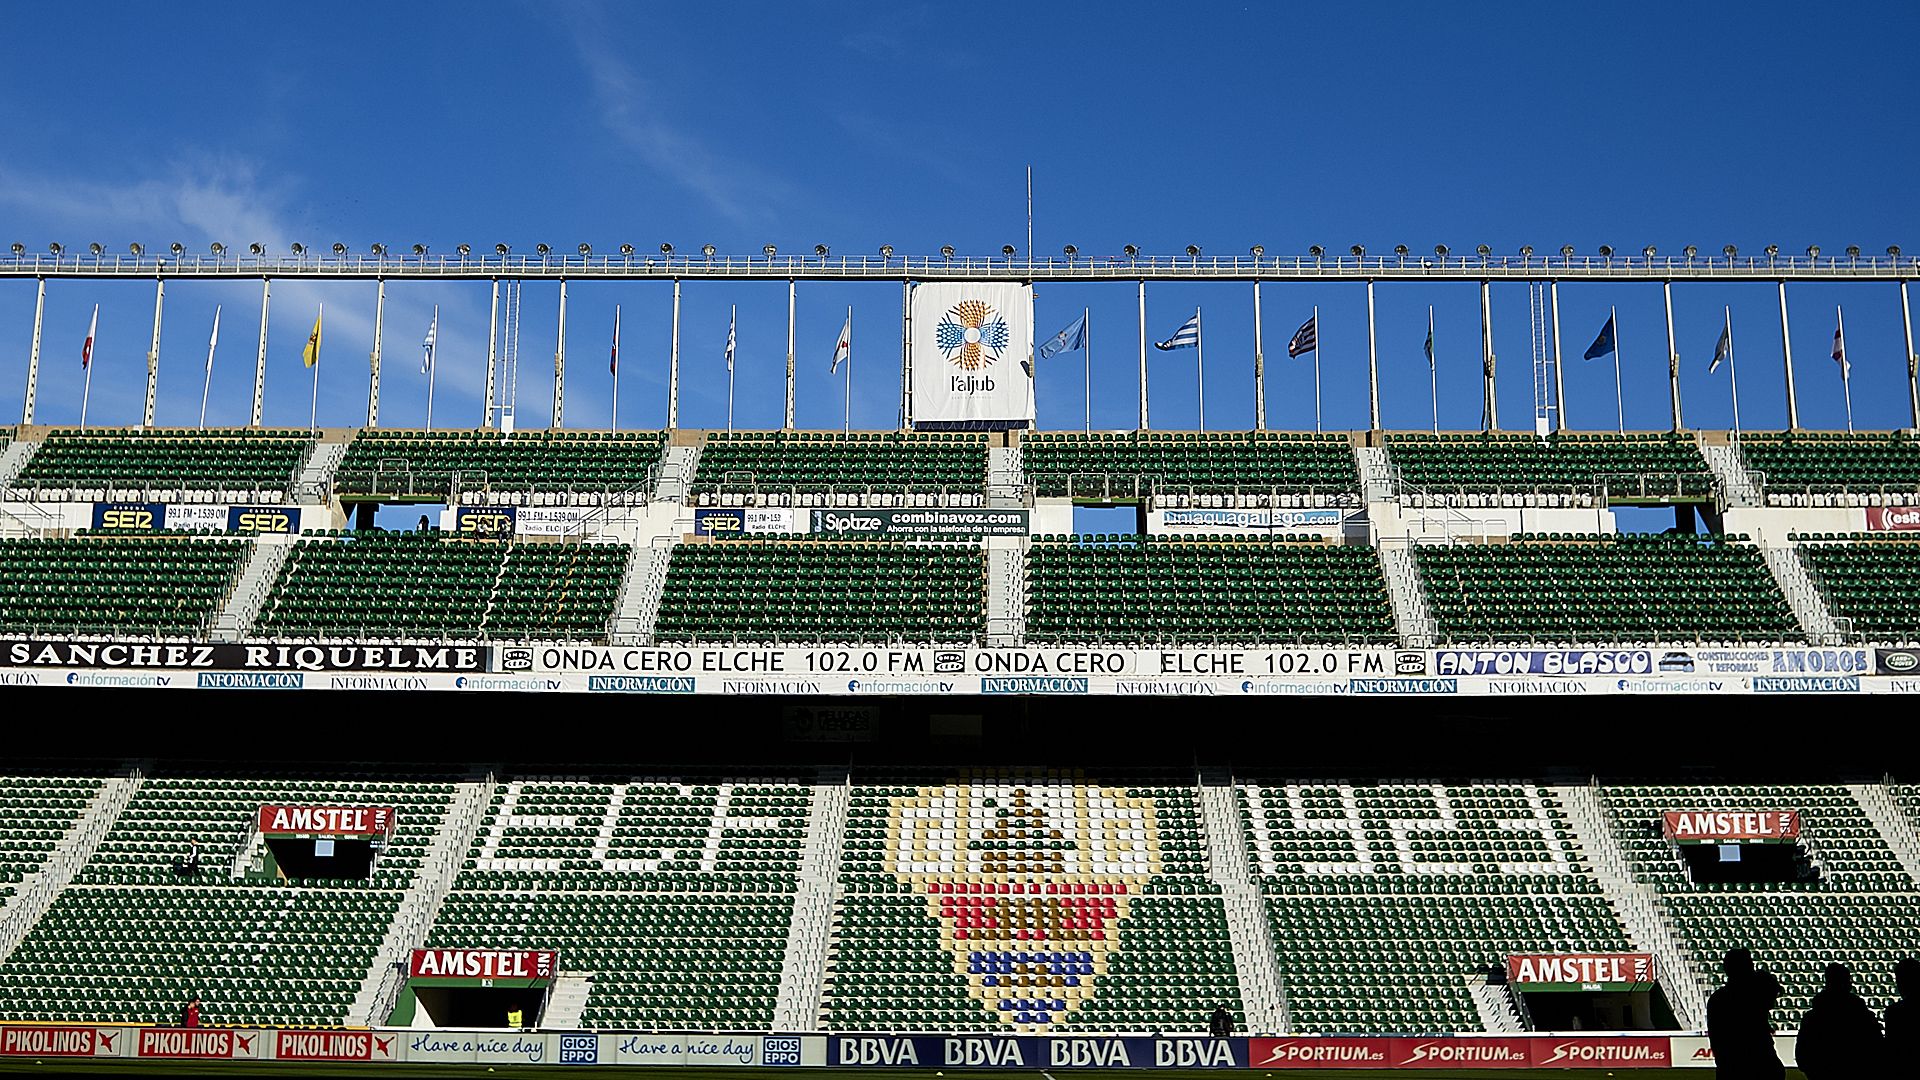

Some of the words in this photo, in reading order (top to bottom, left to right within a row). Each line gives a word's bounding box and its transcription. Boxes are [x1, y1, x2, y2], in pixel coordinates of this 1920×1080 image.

[951, 375, 995, 395] l'aljub
[102, 511, 153, 529] SER
[238, 514, 289, 532] SER
[701, 516, 741, 531] SER
[891, 511, 1022, 524] combinavoz.com
[886, 525, 913, 533] Ahorra
[930, 525, 937, 533] la
[972, 525, 982, 533] de
[992, 526, 1026, 535] empresa
[10, 646, 214, 668] SANCHEZ
[245, 646, 479, 672] RIQUELME
[543, 649, 615, 670] ONDA
[623, 650, 692, 671] CERO
[703, 651, 784, 672] ELCHE
[805, 652, 878, 672] 102.0
[888, 653, 924, 672] FM
[975, 652, 1048, 672] ONDA
[1056, 653, 1124, 673] CERO
[1162, 653, 1244, 673] ELCHE
[1264, 653, 1338, 673] 102.0
[1348, 654, 1384, 673] FM
[1439, 652, 1532, 675] ANTON
[1543, 651, 1650, 674] BLASCO
[1697, 651, 1769, 661] CONSTRUCCIONES
[1772, 651, 1867, 672] AMOROS
[1708, 663, 1714, 672] Y
[1716, 663, 1759, 672] REFORMAS
[200, 672, 302, 688] INFORMACIÓN
[331, 676, 428, 691] INFORMACIÓN
[592, 676, 693, 691] INFORMACIÓN
[723, 680, 821, 694] INFORMACIÓN
[985, 677, 1086, 692] INFORMACIÓN
[1116, 681, 1211, 695] INFORMACIÓN
[1353, 679, 1455, 694] INFORMACIÓN
[1488, 681, 1587, 695] INFORMACIÓN
[1756, 678, 1858, 692] INFORMACIÓN
[374, 810, 387, 831] SIN
[1779, 813, 1791, 835] SIN
[537, 952, 551, 977] SIN
[1634, 958, 1648, 983] SIN
[5, 1030, 91, 1053] PIKOLINOS
[143, 1032, 229, 1056] PIKOLINOS
[281, 1033, 367, 1058] PIKOLINOS
[410, 1036, 460, 1053] Have
[461, 1042, 473, 1053] a
[475, 1038, 508, 1053] nice
[511, 1037, 544, 1062] day
[562, 1038, 596, 1049] GIOS
[618, 1037, 668, 1054] Have
[670, 1044, 682, 1054] a
[686, 1039, 717, 1054] nice
[722, 1038, 754, 1063] day
[766, 1039, 798, 1051] GIOS
[561, 1050, 596, 1062] EPPO
[764, 1052, 798, 1063] EPPO
[839, 1039, 919, 1065] BBVA
[944, 1039, 1024, 1065] BBVA
[1050, 1039, 1130, 1066] BBVA
[1155, 1040, 1236, 1067] BBVA
[1259, 1041, 1384, 1066] SPORTIUM.es
[1399, 1041, 1525, 1066] SPORTIUM.es
[1540, 1041, 1665, 1065] SPORTIUM.es
